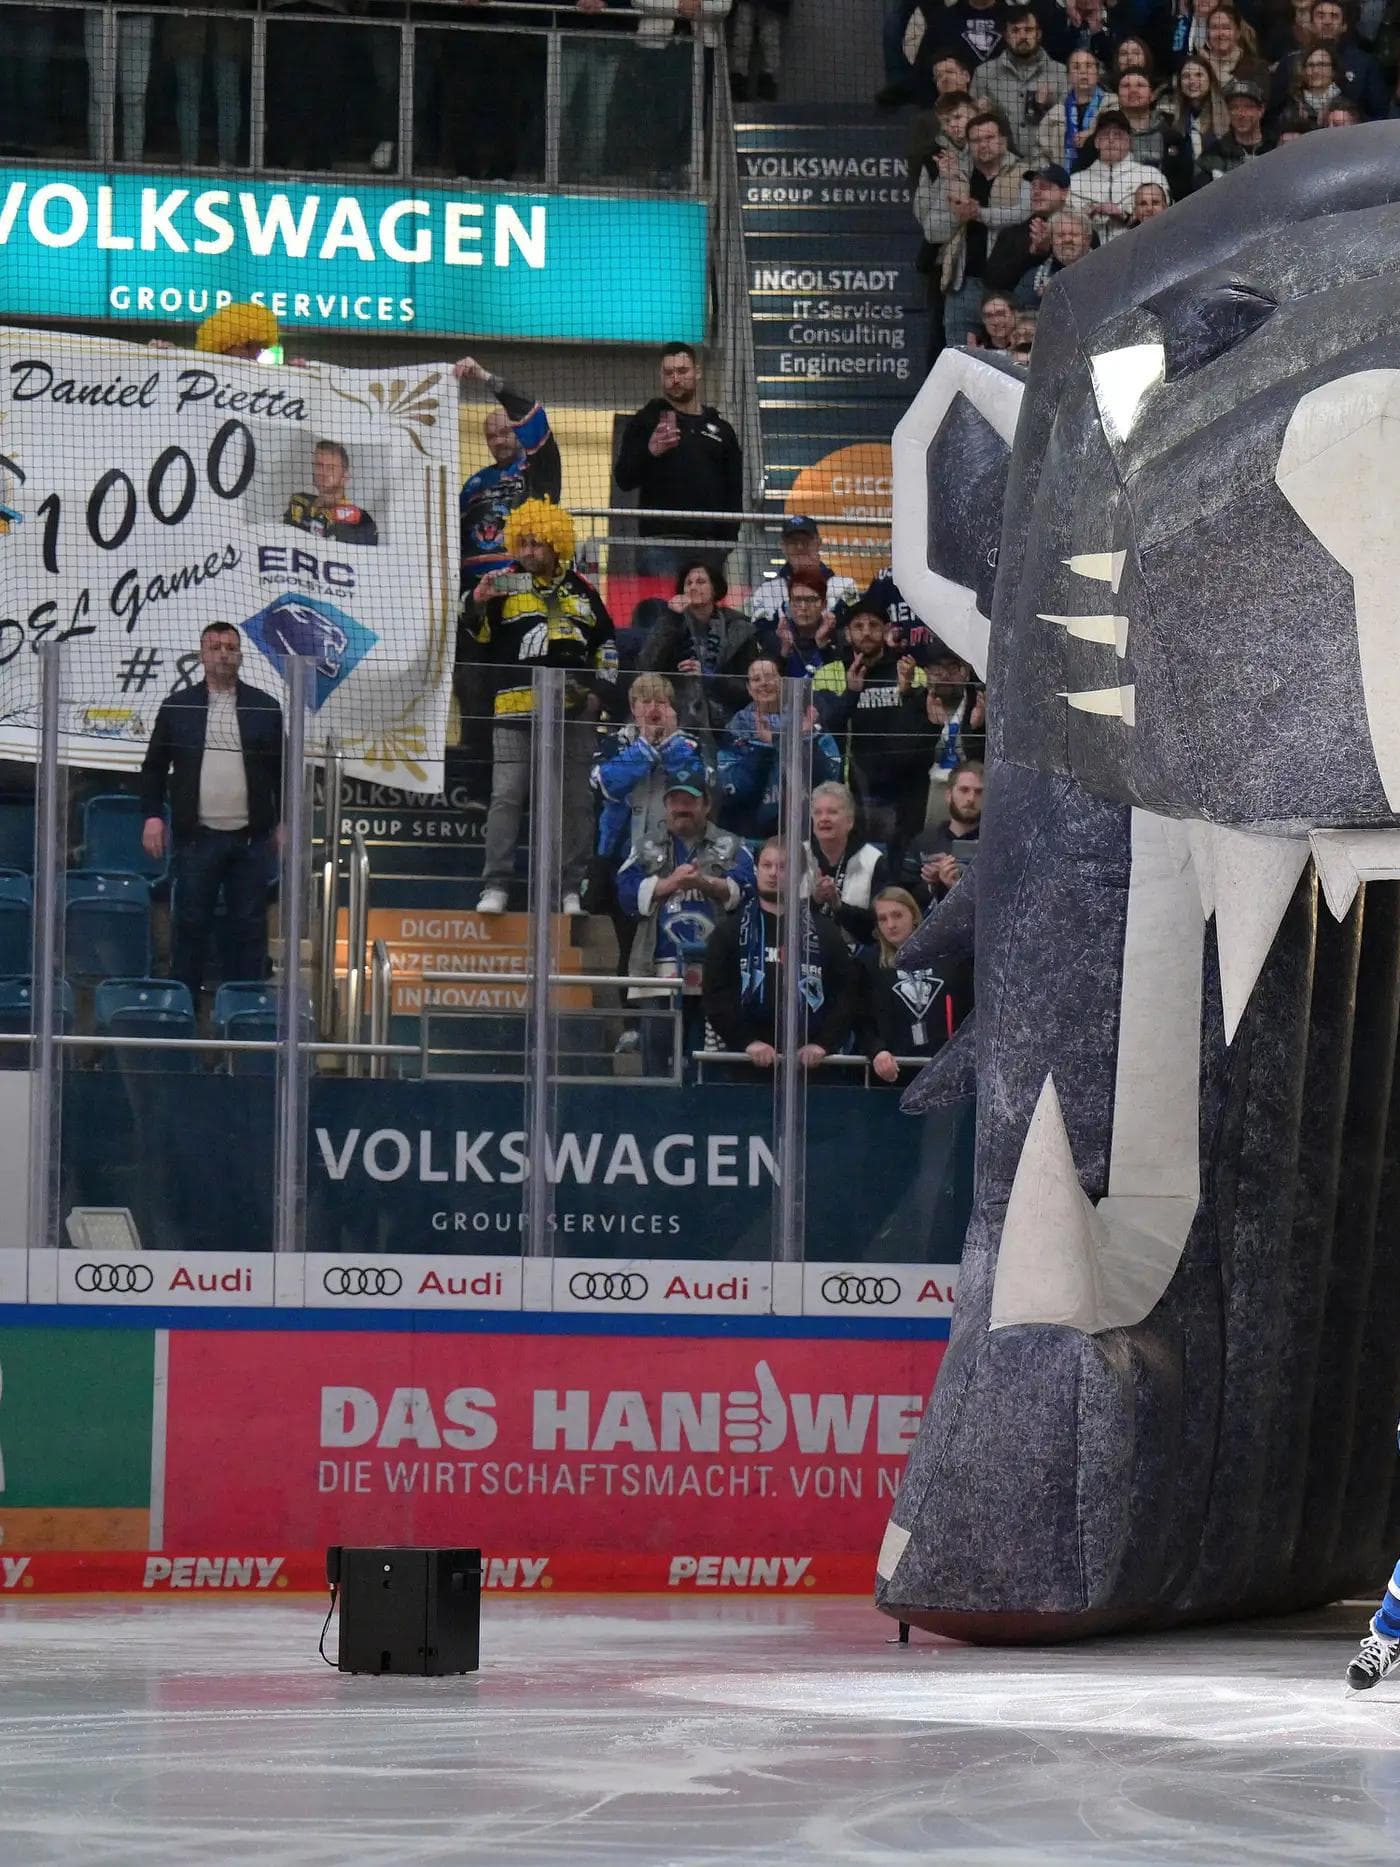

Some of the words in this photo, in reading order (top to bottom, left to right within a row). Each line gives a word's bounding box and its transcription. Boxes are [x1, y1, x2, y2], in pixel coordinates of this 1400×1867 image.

[746, 158, 908, 177] VOLKSWAGEN
[747, 187, 813, 202] GROUP
[821, 188, 910, 203] SERVICES
[754, 270, 899, 290] INGOLSTADT
[110, 286, 231, 314] GROUP
[251, 292, 415, 321] SERVICES
[793, 301, 904, 320] IT-Services
[789, 324, 905, 348] Consulting
[779, 352, 910, 379] Engineering
[11, 360, 160, 409] Daniel
[176, 369, 309, 421] Pietta
[38, 419, 256, 573] 1000
[258, 546, 355, 588] ERC
[110, 543, 242, 633] Games
[259, 574, 356, 599] INGOLSTADT
[116, 647, 202, 694] #8
[316, 784, 468, 808] OLKSWAG
[341, 819, 402, 836] ROUP
[412, 820, 489, 838] SERVIC
[401, 919, 491, 940] DIGITAL
[315, 1127, 782, 1187] VOLKSWAGEN
[168, 1267, 252, 1293] Audi
[417, 1271, 503, 1297] Audi
[664, 1276, 749, 1301] Audi
[916, 1279, 954, 1303] Au
[320, 1386, 498, 1451] DAS
[532, 1361, 924, 1455] HANDWE
[318, 1460, 373, 1494] DIE
[384, 1461, 778, 1498] WIRTSCHAFTSMACHT.
[789, 1465, 863, 1498] VON
